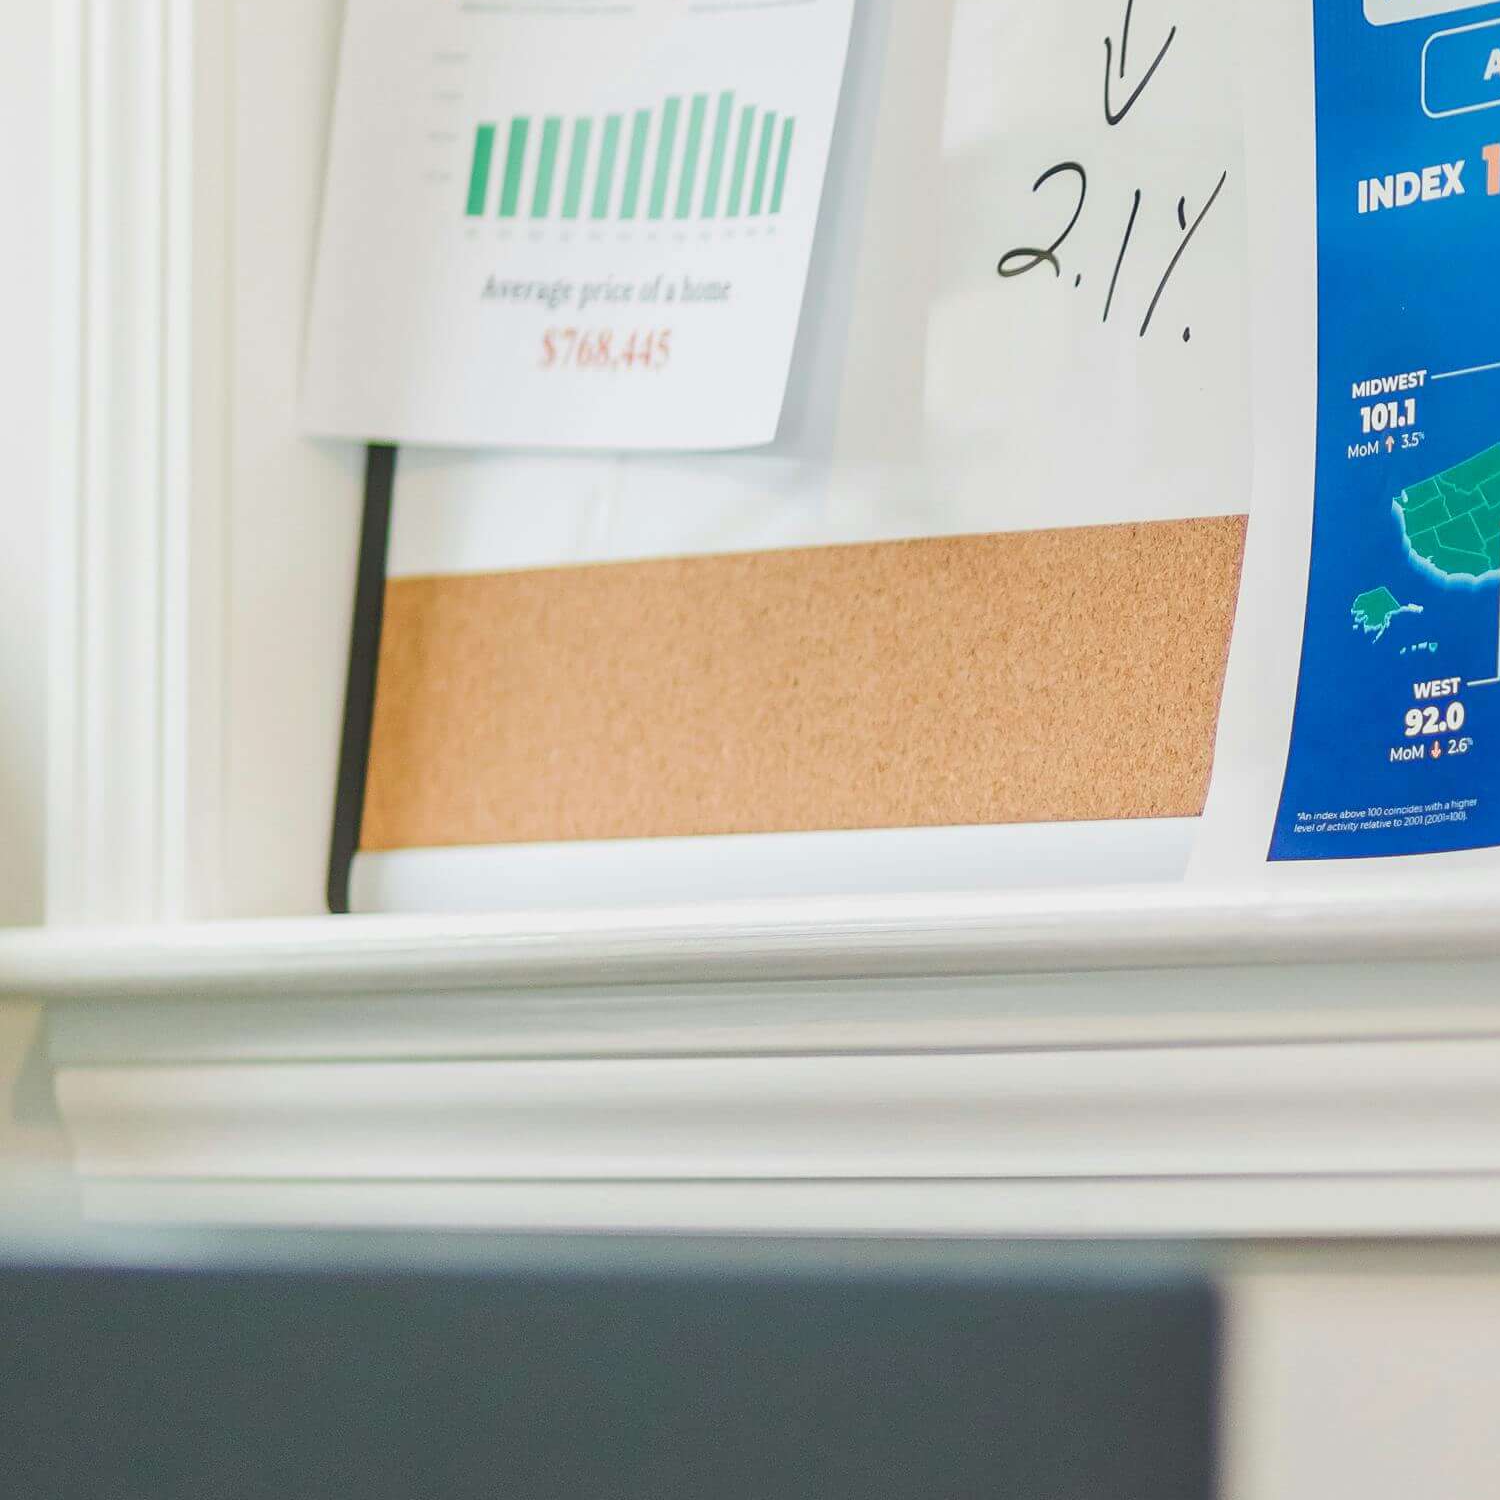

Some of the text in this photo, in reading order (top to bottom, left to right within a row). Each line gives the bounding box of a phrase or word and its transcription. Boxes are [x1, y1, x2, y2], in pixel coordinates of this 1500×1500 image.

[1357, 160, 1465, 213] INDEX
[480, 274, 571, 311] Average
[576, 274, 634, 311] price
[639, 273, 665, 302] of
[680, 275, 732, 302] home
[1351, 369, 1427, 399] MIDWEST
[1360, 398, 1415, 433] 101.1
[1347, 440, 1379, 459] MoM
[1413, 677, 1461, 699] WEST
[1404, 701, 1464, 736] 92.0
[1390, 744, 1424, 762] MoM
[1313, 810, 1337, 820] index
[1339, 809, 1366, 819] above
[1367, 807, 1382, 817] 100
[1424, 801, 1443, 812] with
[1443, 802, 1450, 810] a
[1451, 798, 1478, 810] higher
[1293, 824, 1315, 833] level
[1316, 822, 1327, 832] of
[1327, 821, 1359, 833] activity
[1360, 819, 1391, 830] relative
[1393, 818, 1402, 827] to
[1404, 815, 1423, 827] 2001
